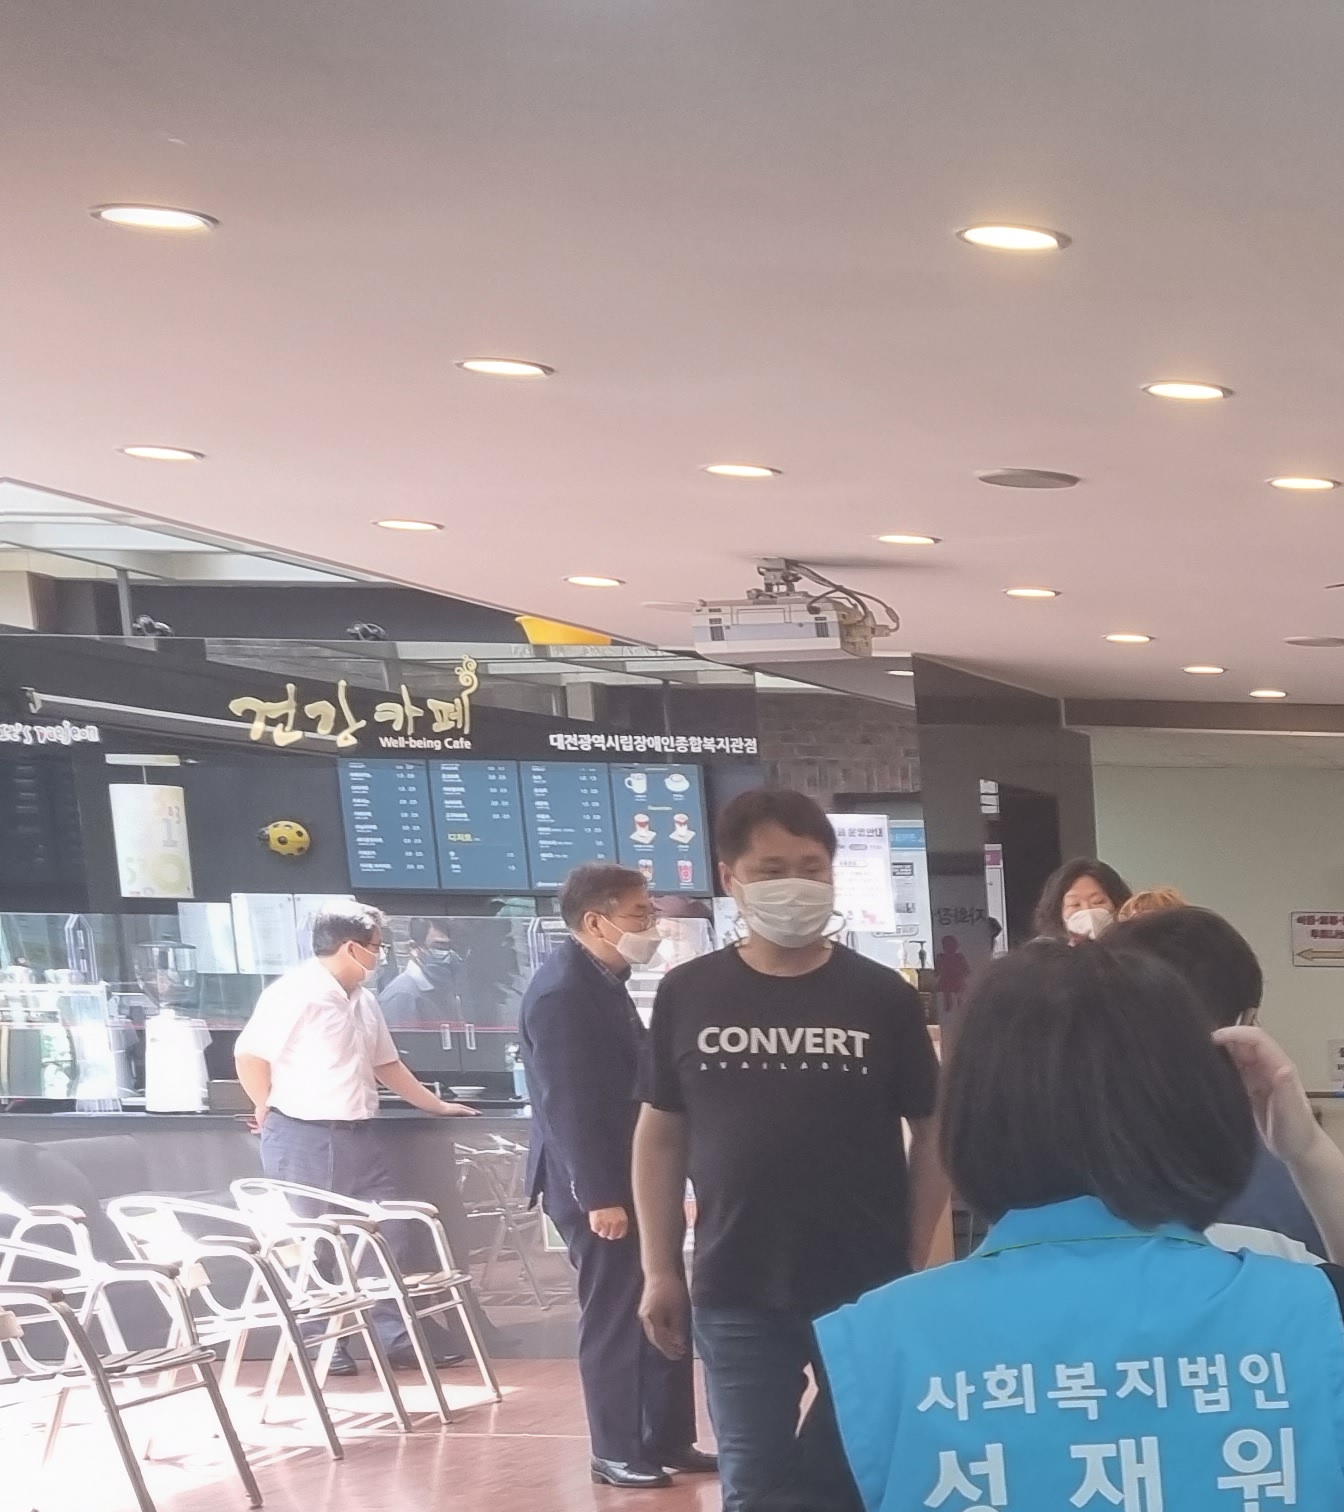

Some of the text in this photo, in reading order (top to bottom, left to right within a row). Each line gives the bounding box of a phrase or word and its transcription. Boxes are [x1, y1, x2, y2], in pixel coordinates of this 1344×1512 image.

[378, 737, 472, 750] Well-being Cafe
[548, 733, 759, 754] 대전광역시립장애인종합복지관점
[697, 1026, 870, 1058] CONVERT
[916, 1352, 1291, 1422] 사회복지법인
